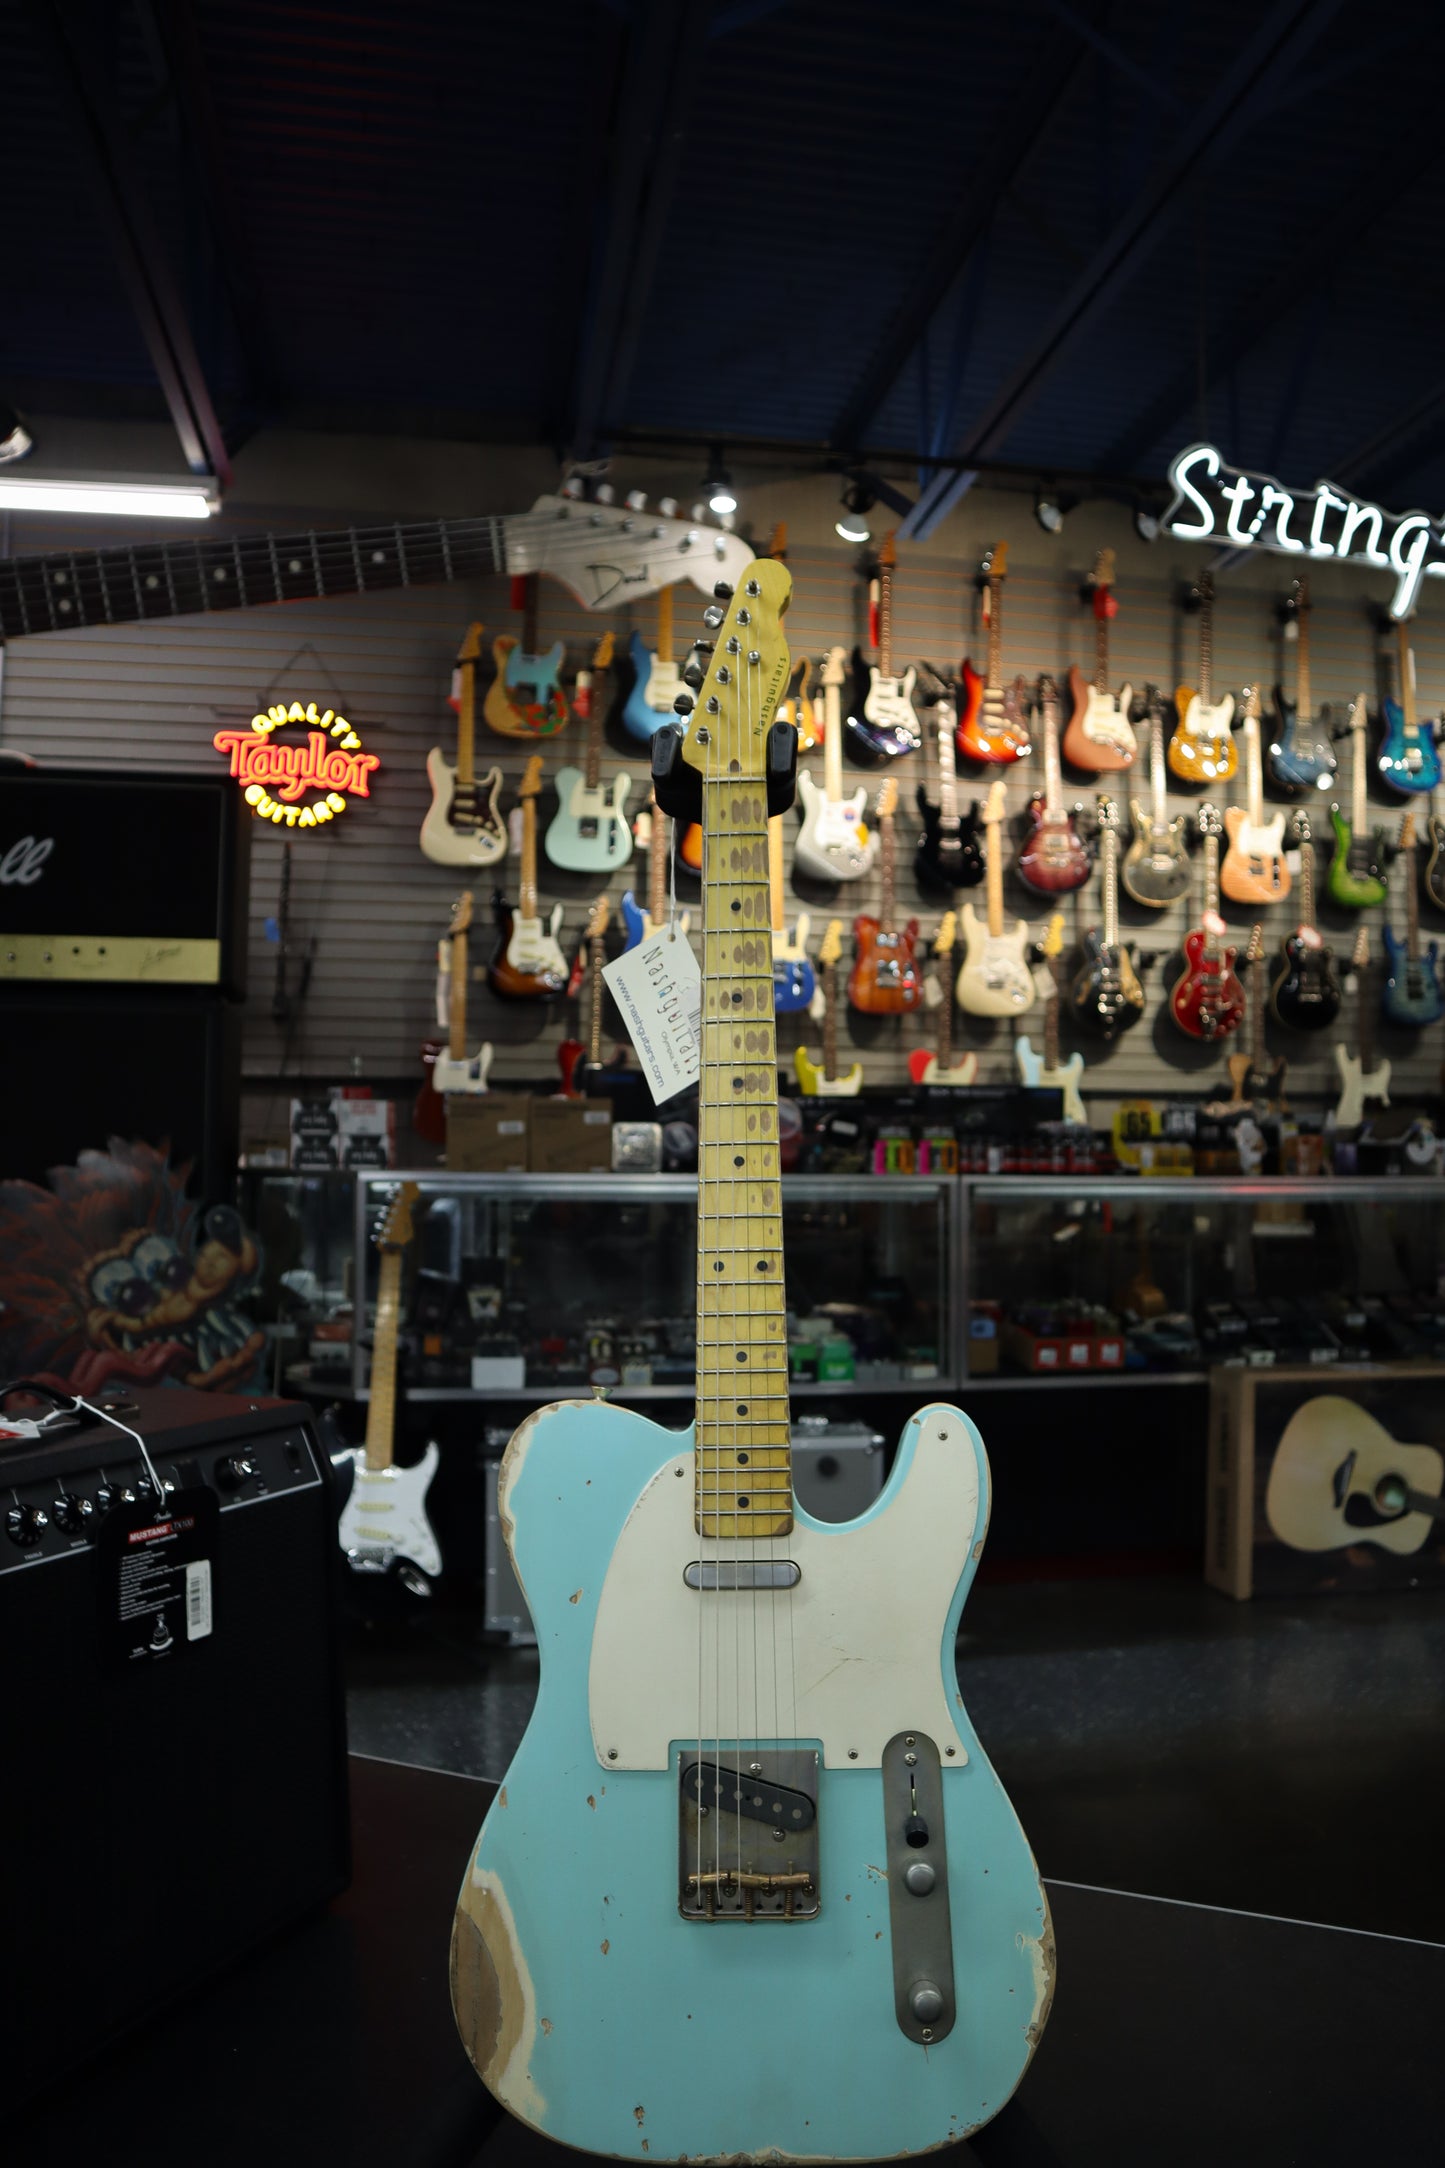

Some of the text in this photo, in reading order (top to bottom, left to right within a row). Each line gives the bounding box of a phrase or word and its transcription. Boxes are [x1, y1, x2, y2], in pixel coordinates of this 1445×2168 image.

[1170, 447, 1445, 617] String
[251, 701, 362, 750] QUALITY
[753, 656, 787, 737] Nashguitars
[213, 730, 381, 801] Taylor
[244, 784, 346, 828] GUITARS
[615, 975, 665, 1088] www.nashguitars.com
[129, 1525, 168, 1543] MUSTANG
